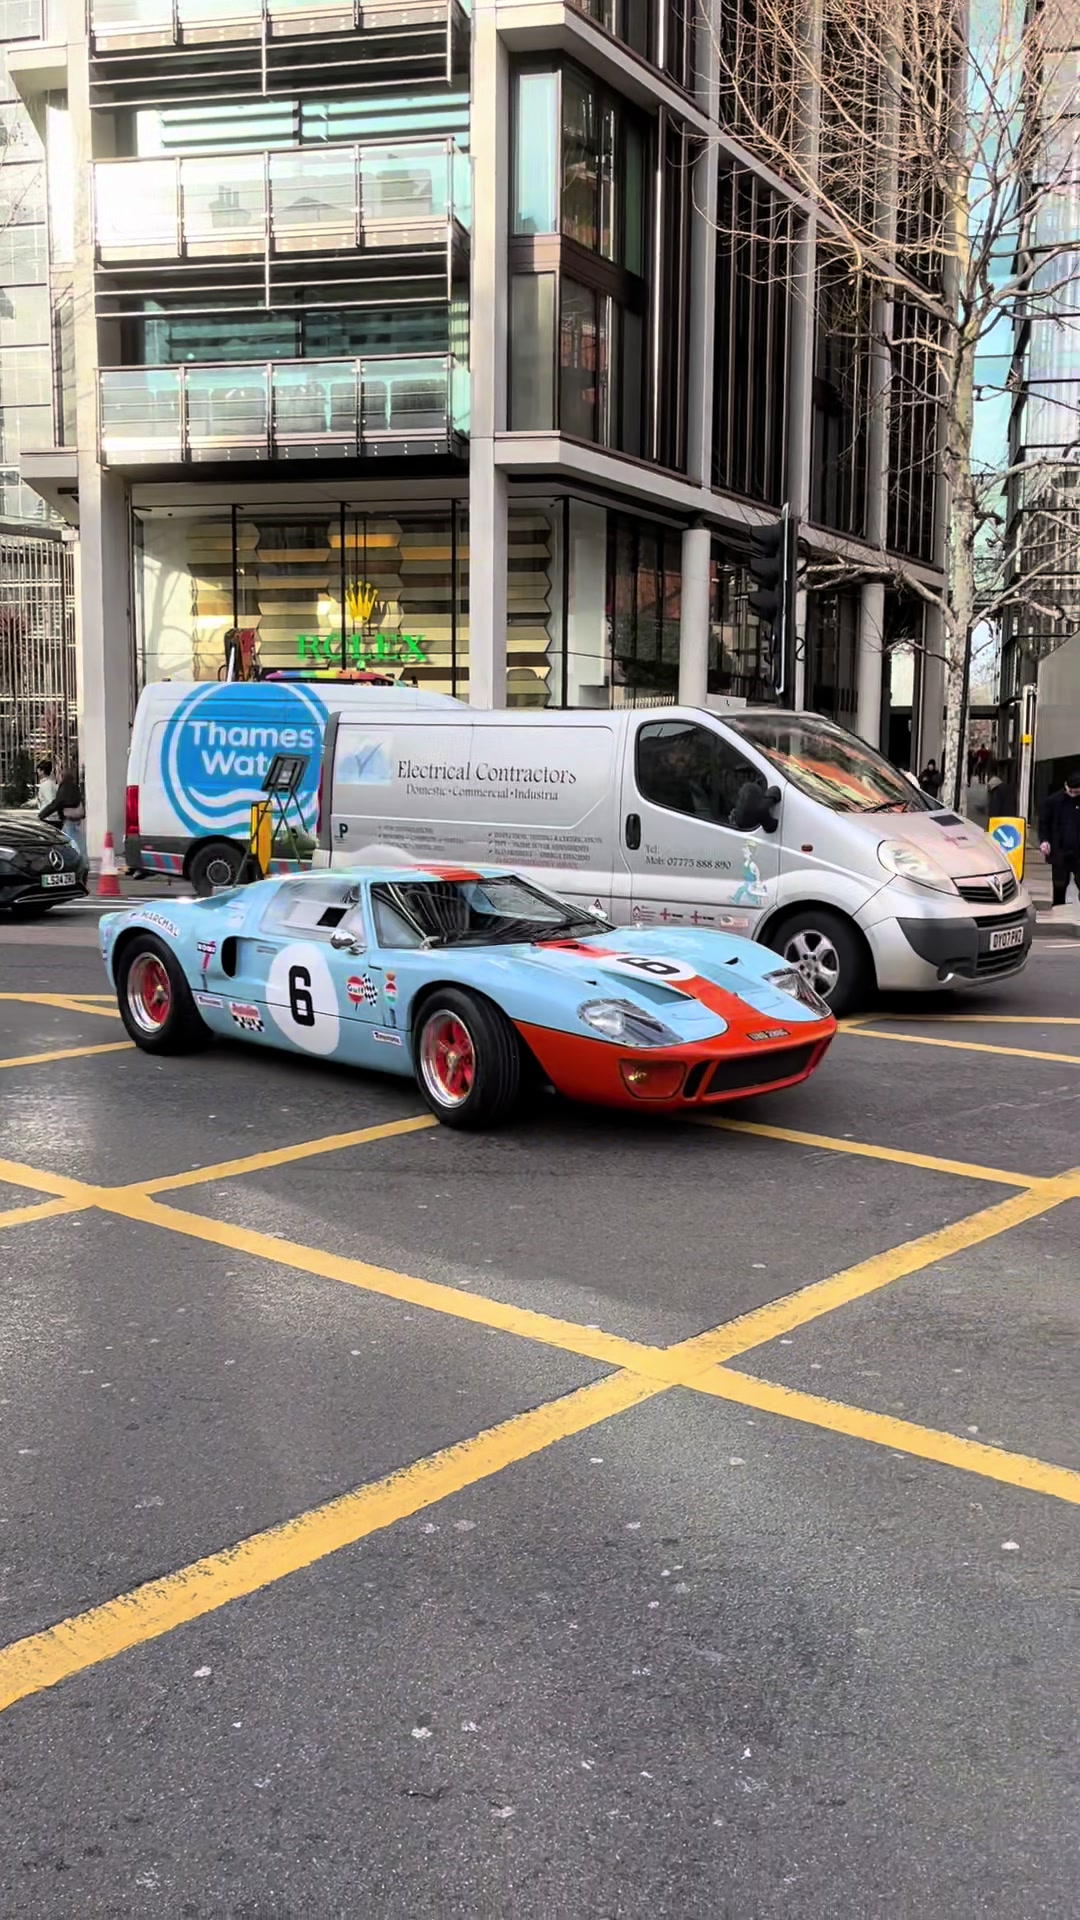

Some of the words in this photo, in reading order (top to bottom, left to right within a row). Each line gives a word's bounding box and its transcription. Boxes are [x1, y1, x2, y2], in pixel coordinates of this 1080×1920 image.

[296, 633, 427, 662] ROLEX
[187, 720, 315, 748] Thames
[201, 750, 273, 777] Wat
[398, 760, 471, 781] Electrical
[475, 762, 577, 785] Contractors
[406, 784, 446, 796] Domestic
[452, 786, 509, 799] Commercial
[141, 911, 179, 937] MARCHAL
[616, 957, 680, 975] 6
[289, 965, 315, 1027] 6
[347, 984, 364, 994] Gulf
